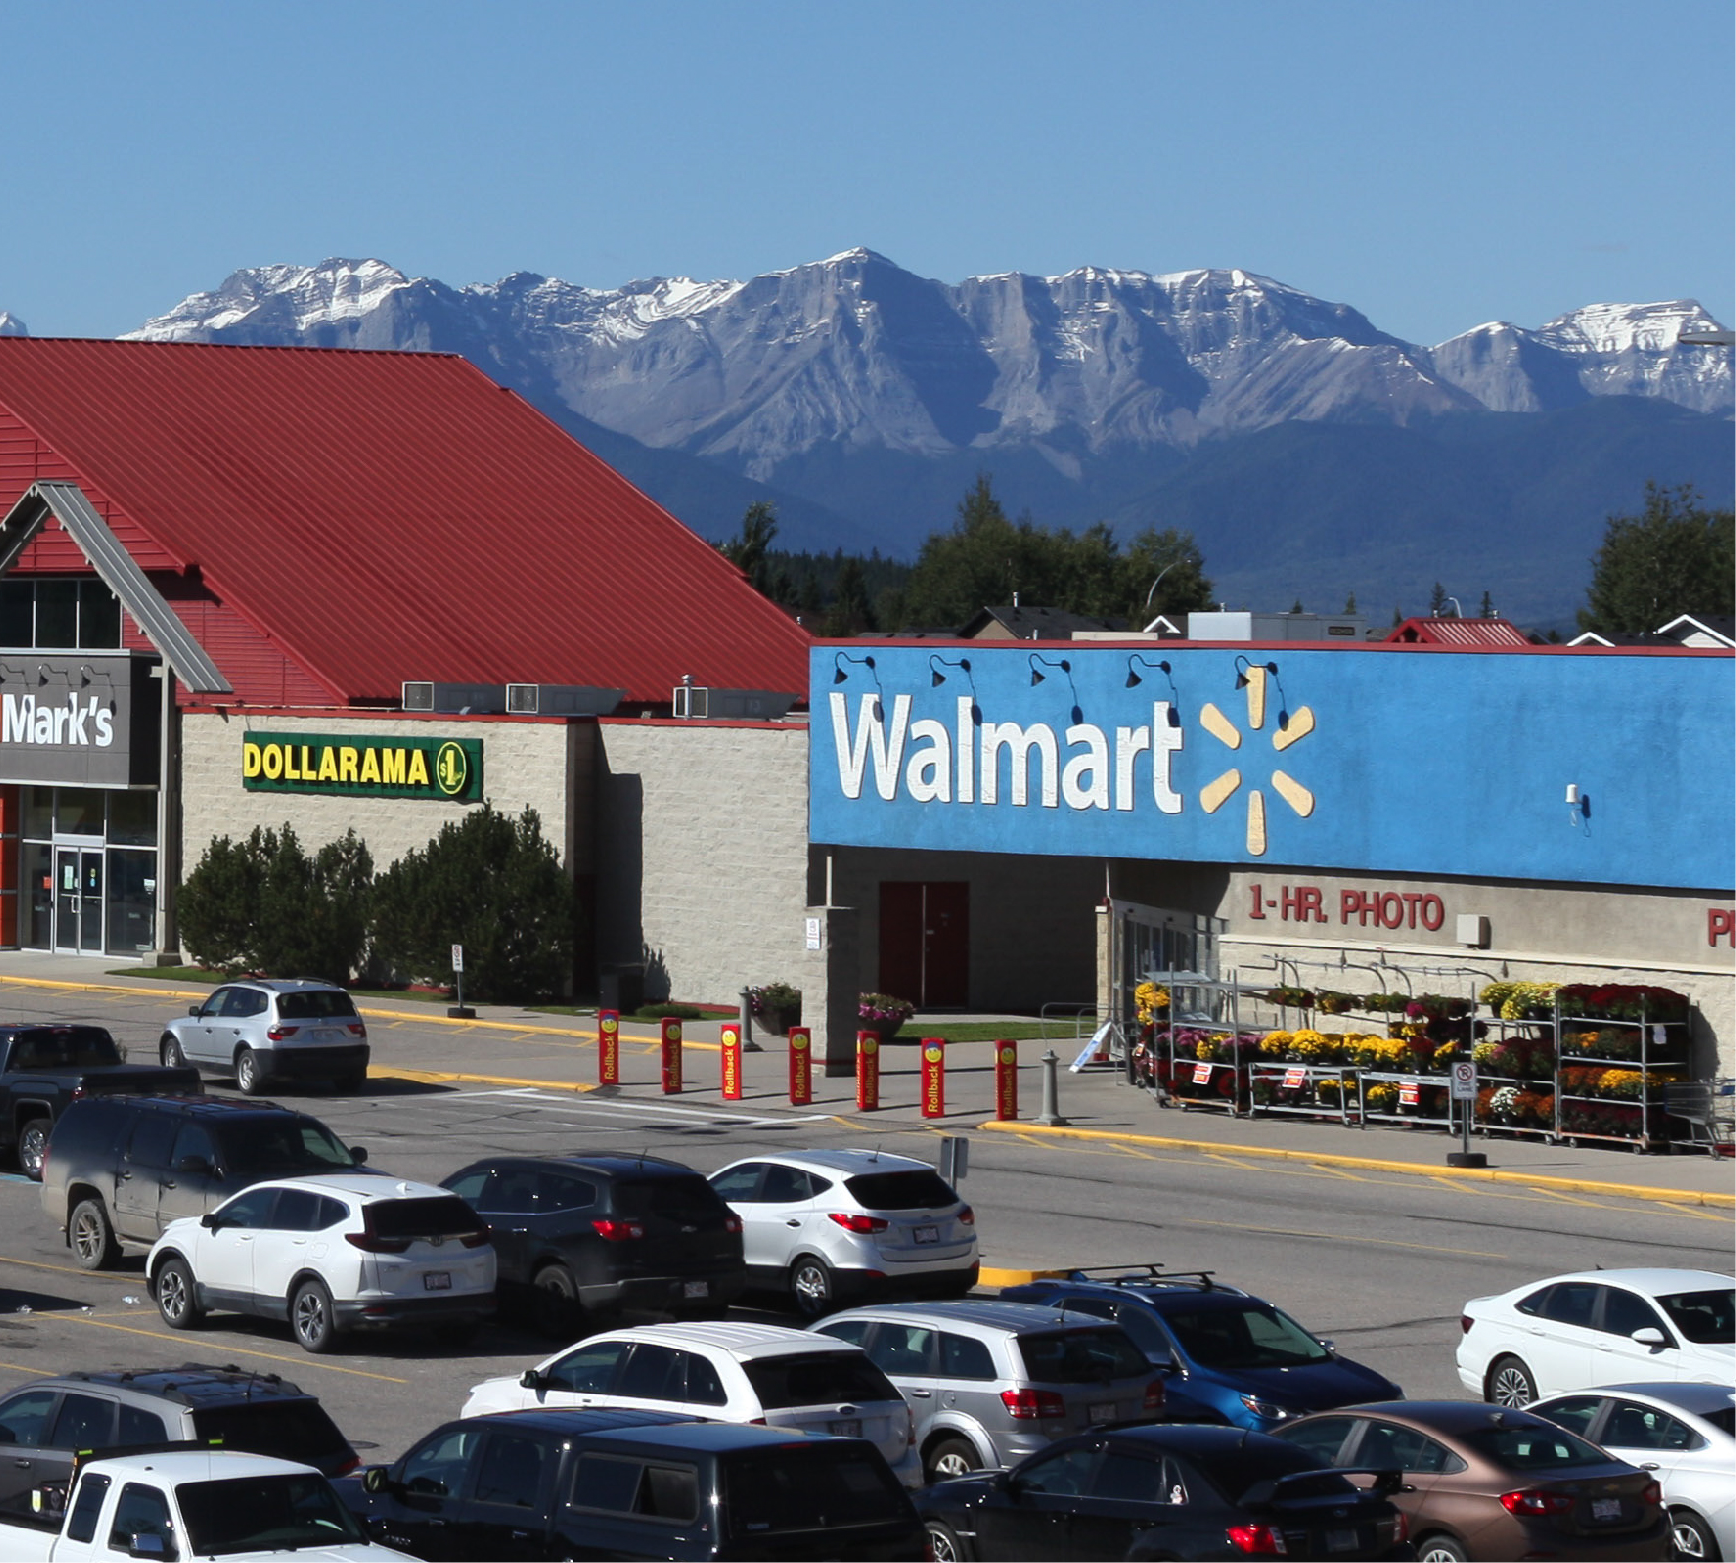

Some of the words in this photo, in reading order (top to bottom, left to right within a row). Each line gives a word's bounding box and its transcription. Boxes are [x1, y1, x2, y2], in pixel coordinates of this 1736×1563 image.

[1, 691, 113, 747] Mark's
[243, 742, 429, 785] DOLLARAMA
[829, 692, 1184, 814] Walmart
[1340, 889, 1445, 931] PHOTO
[604, 1035, 615, 1080] Rollback
[668, 1043, 679, 1087] Rollback
[725, 1049, 735, 1094] Rollback
[795, 1053, 805, 1098] Rollback
[865, 1058, 875, 1104] Rollback
[928, 1065, 939, 1113] Rollback
[1003, 1068, 1013, 1115] Rollback
